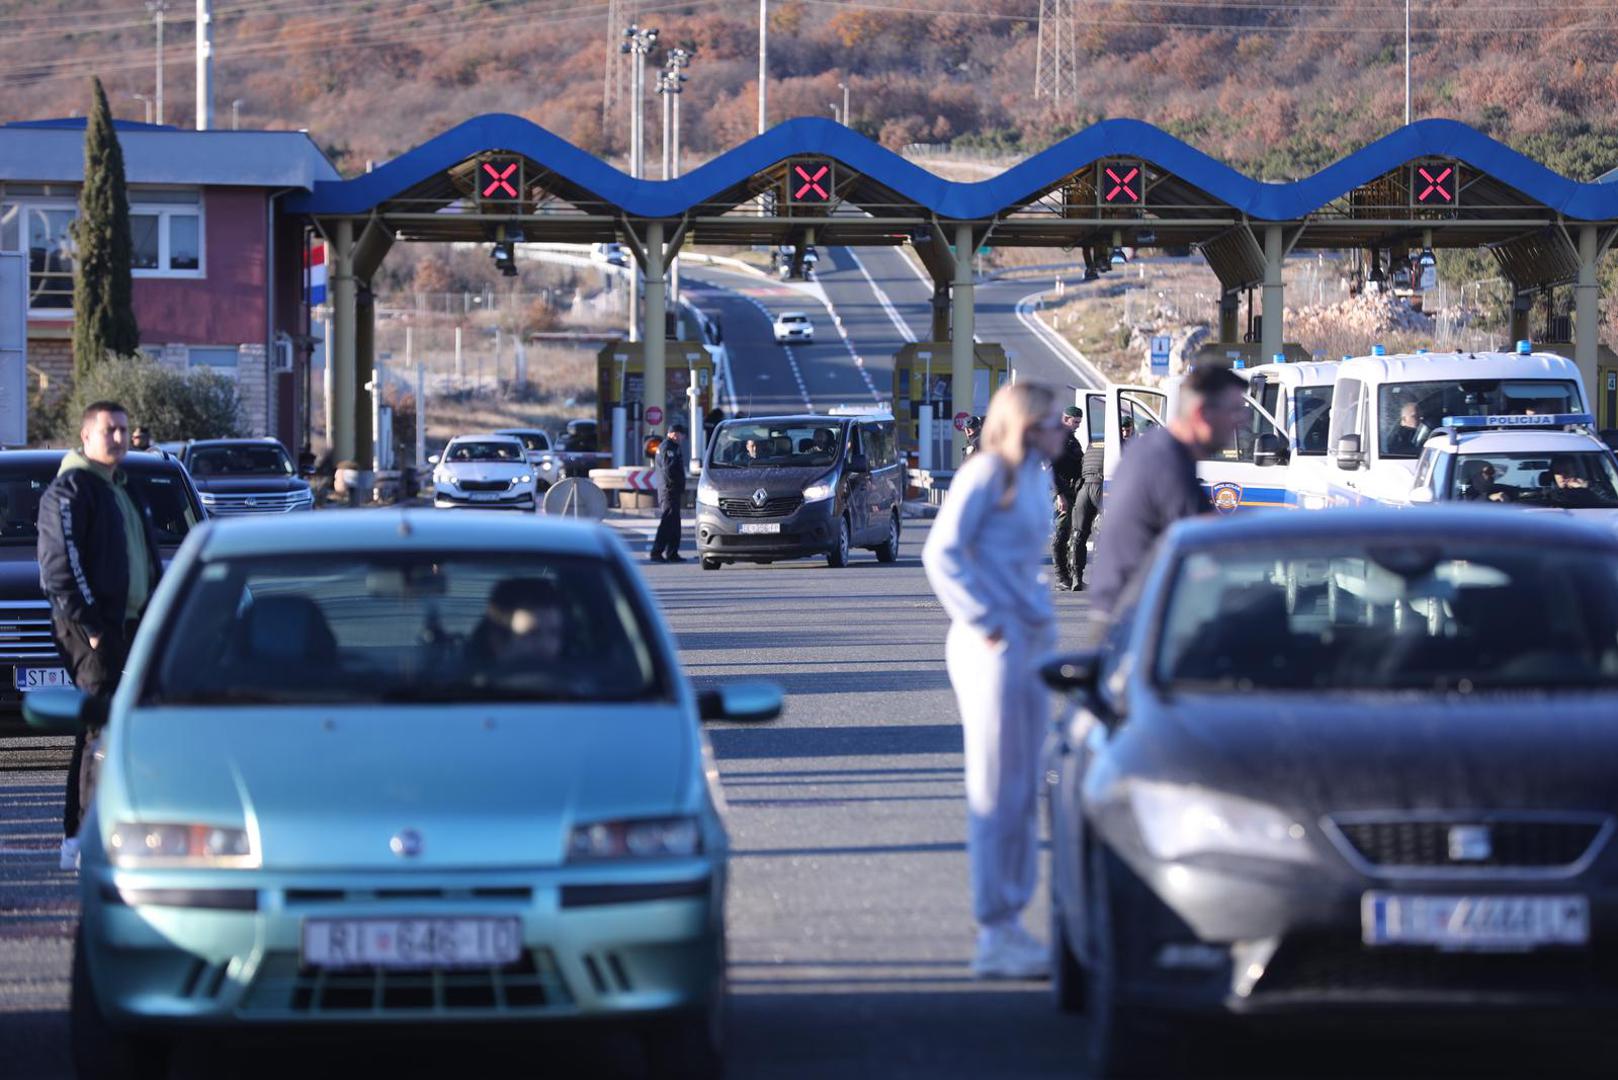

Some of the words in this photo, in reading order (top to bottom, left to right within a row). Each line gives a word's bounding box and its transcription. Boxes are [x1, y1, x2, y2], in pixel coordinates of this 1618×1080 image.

[1489, 415, 1551, 426] POLICIJA
[28, 669, 47, 686] ST
[329, 922, 366, 960] RI
